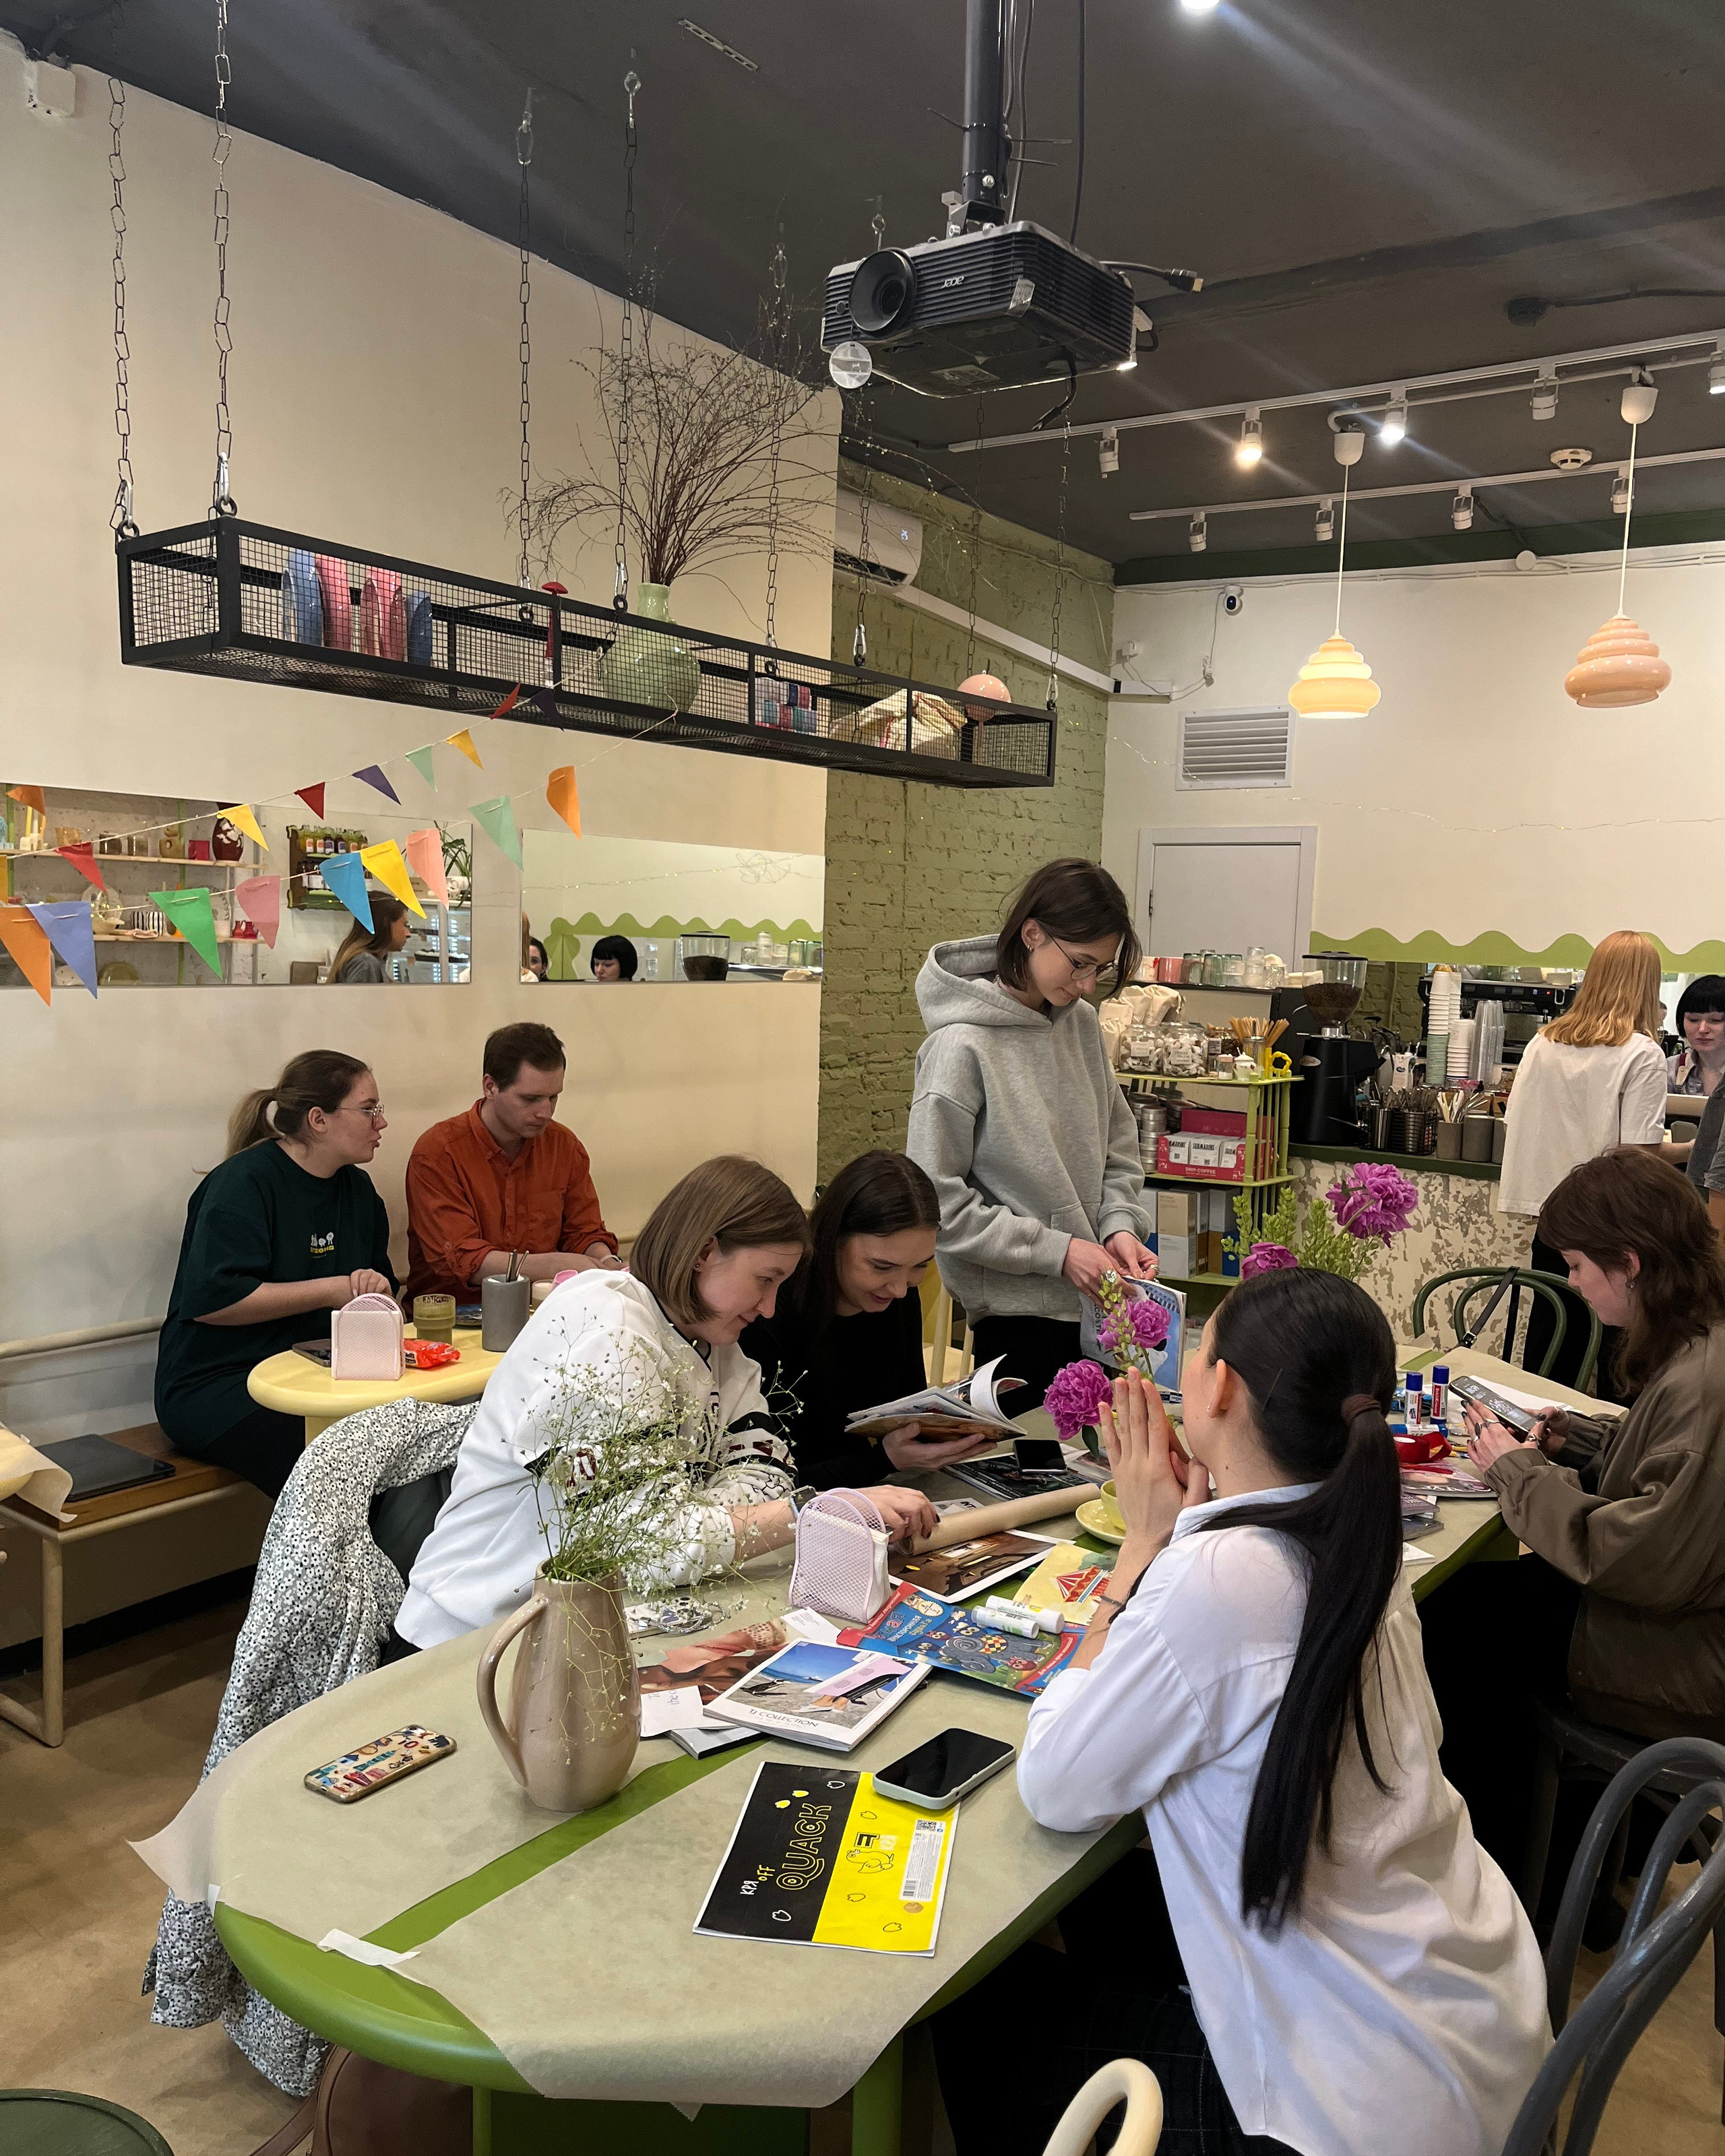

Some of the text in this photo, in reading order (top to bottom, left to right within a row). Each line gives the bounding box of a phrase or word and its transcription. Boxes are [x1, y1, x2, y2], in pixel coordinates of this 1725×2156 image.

[941, 276, 964, 288] acer
[759, 1711, 819, 1727] COLLECTION
[776, 1803, 832, 1891] QUACK
